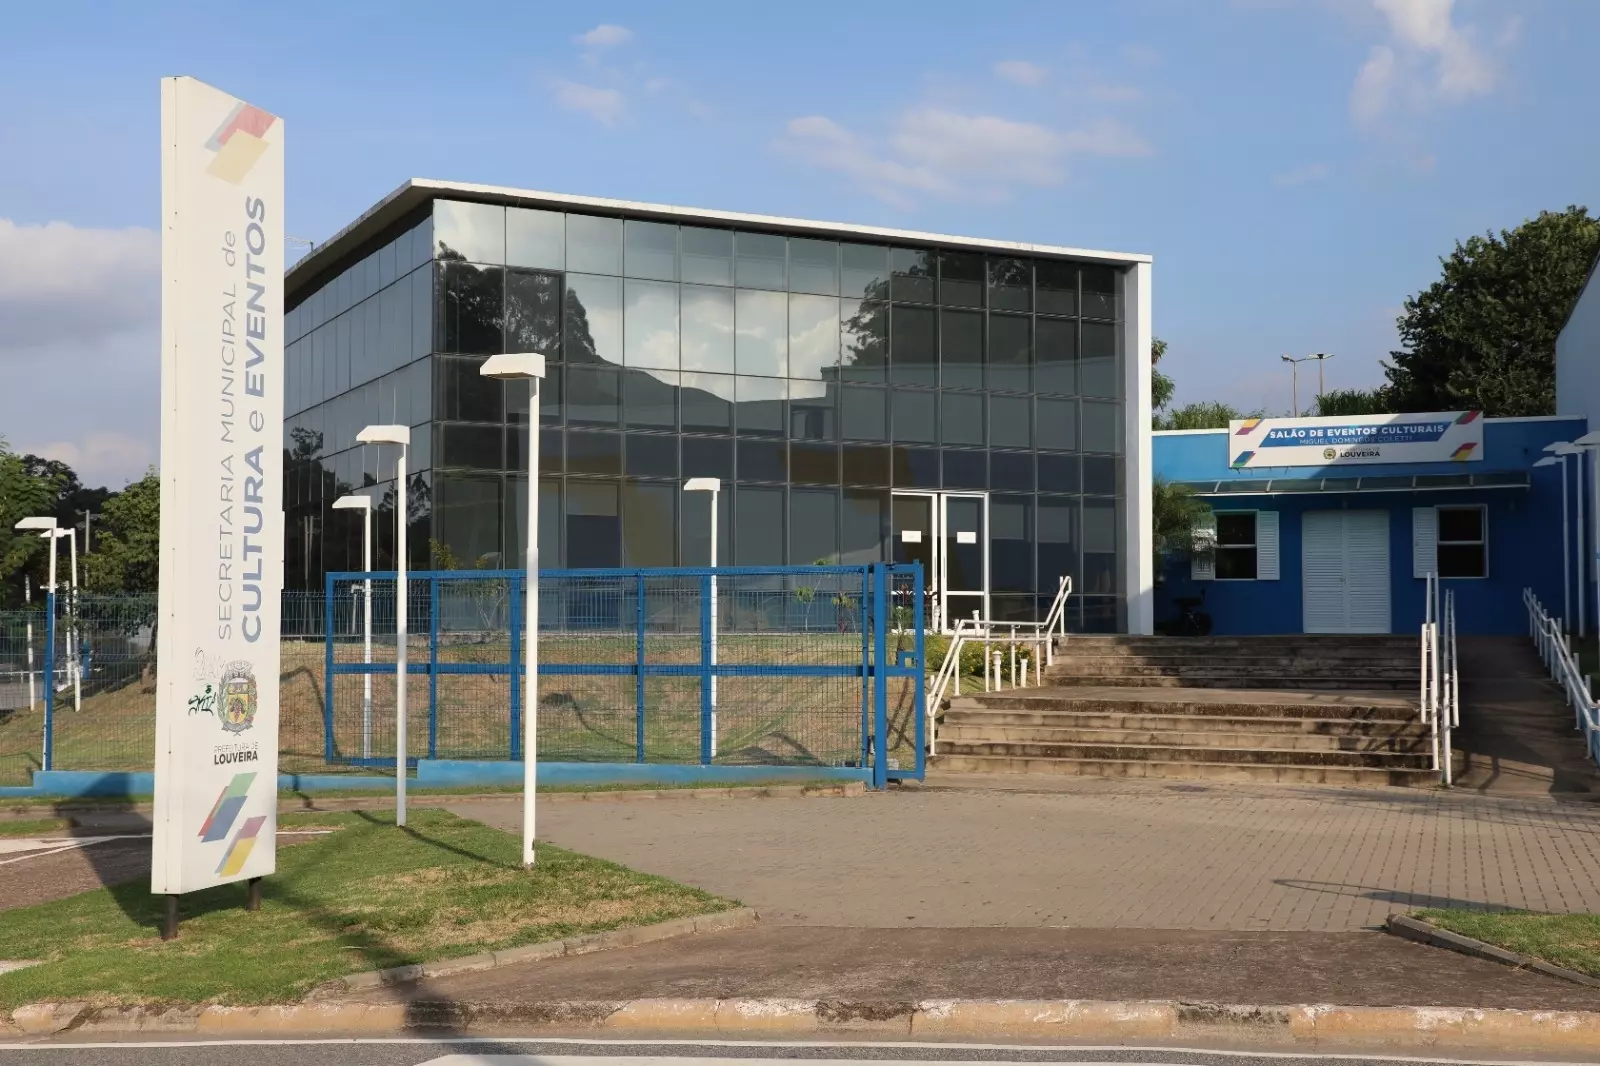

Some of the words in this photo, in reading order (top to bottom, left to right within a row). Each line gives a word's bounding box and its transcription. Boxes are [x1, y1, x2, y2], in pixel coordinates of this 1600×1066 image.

[221, 230, 236, 267] de
[245, 195, 266, 398] EVENTOS
[220, 283, 236, 443] MUNICIPAL
[249, 409, 264, 432] e
[1269, 428, 1306, 439] SALÃO
[1309, 428, 1324, 437] DE
[1327, 426, 1377, 437] EVENTOS
[1381, 424, 1444, 435] CULTURAIS
[1340, 450, 1381, 458] LOUVEIRA
[218, 454, 235, 641] SECRETARIA
[241, 445, 264, 643] CULTURA
[213, 750, 259, 765] LOUVEIRA
